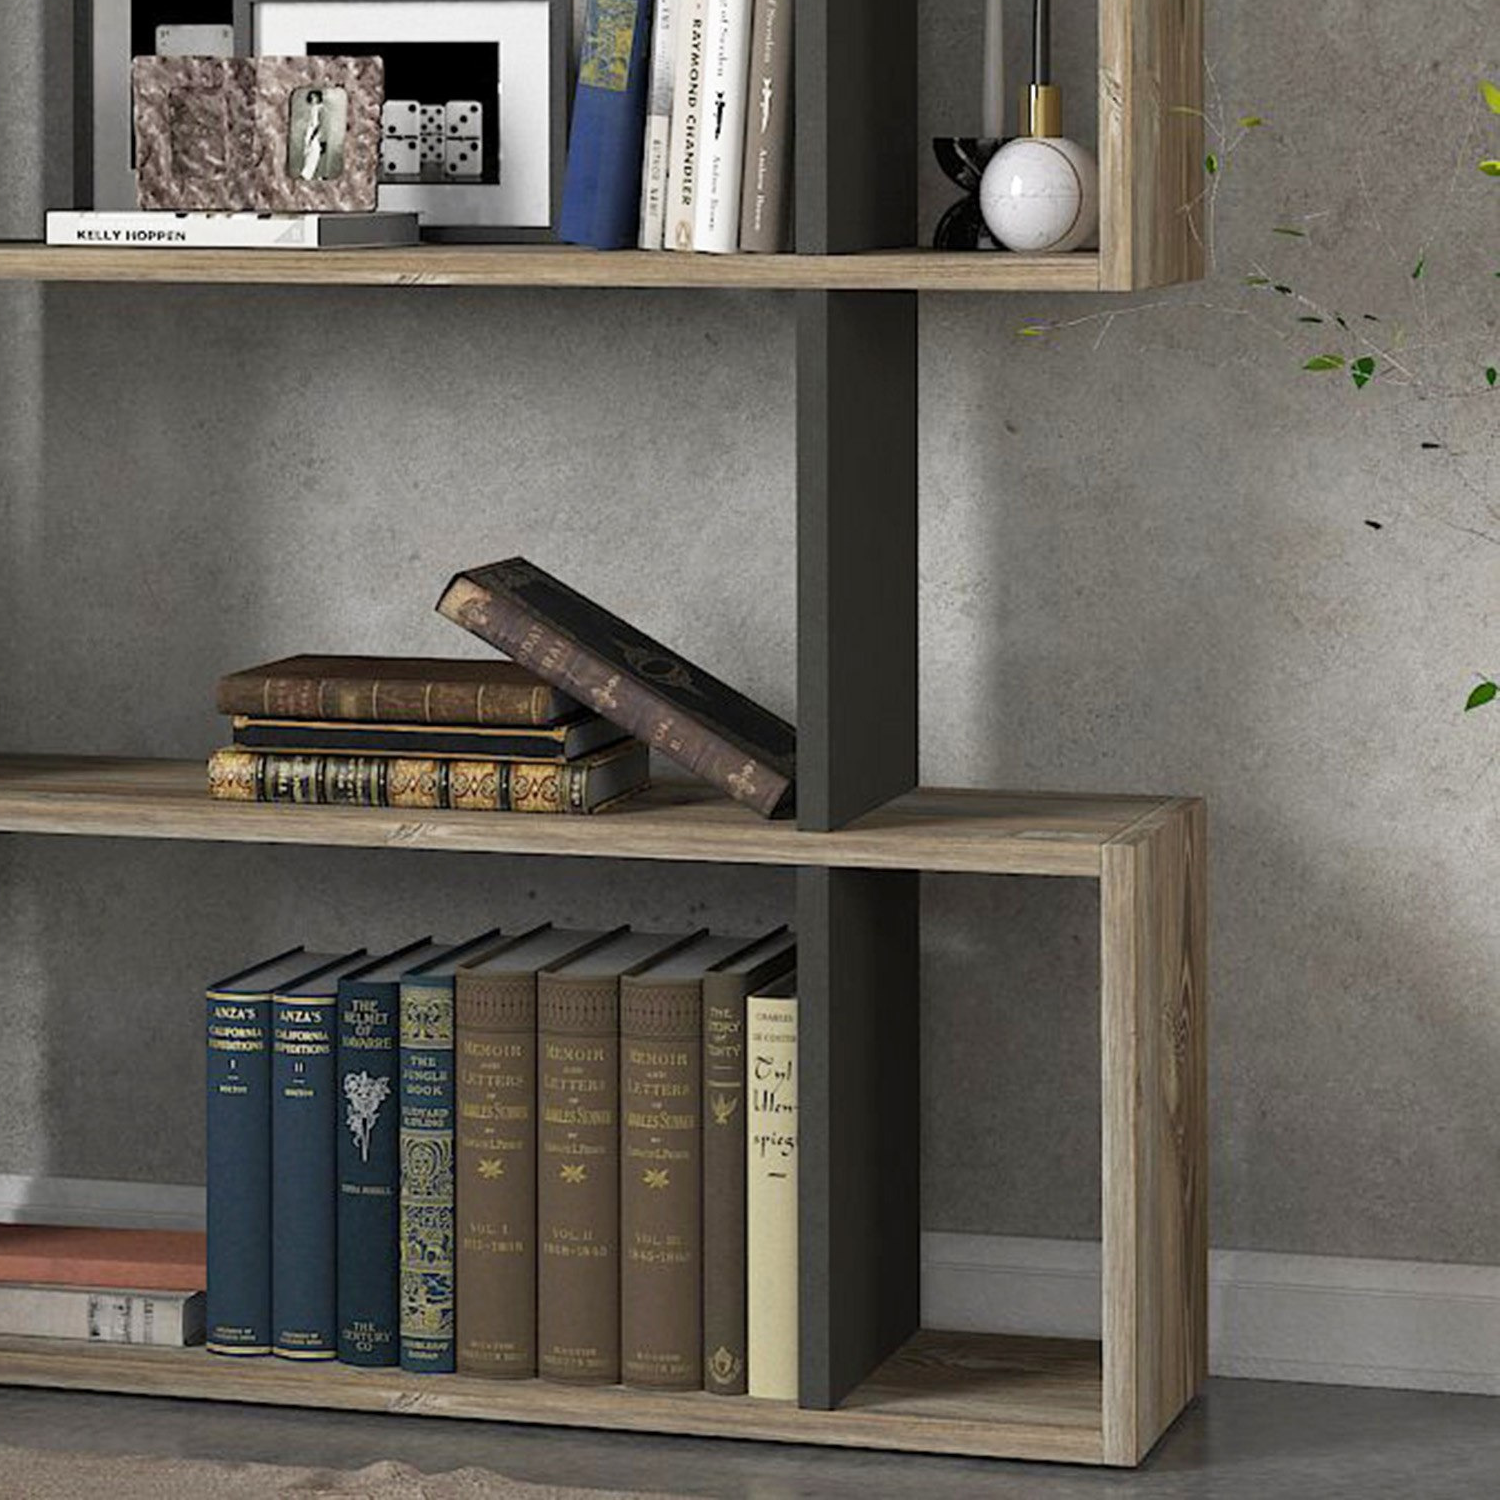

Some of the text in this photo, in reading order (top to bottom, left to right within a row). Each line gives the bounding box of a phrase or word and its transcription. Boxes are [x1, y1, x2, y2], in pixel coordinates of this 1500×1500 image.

[722, 11, 729, 25] of
[687, 18, 702, 108] RAYMOND
[680, 114, 697, 206] CHANDLER
[756, 150, 768, 190] Andrew
[77, 230, 186, 241] KELLY HOPPEN
[214, 1006, 256, 1020] ANZA'S
[352, 1000, 378, 1012] THE
[280, 1010, 322, 1023] ANZA'S
[463, 1040, 522, 1057] MEMOIR
[546, 1042, 604, 1062] MEMOIR
[294, 1062, 304, 1073] II
[411, 1055, 436, 1068] THE
[353, 1321, 376, 1333] THE
